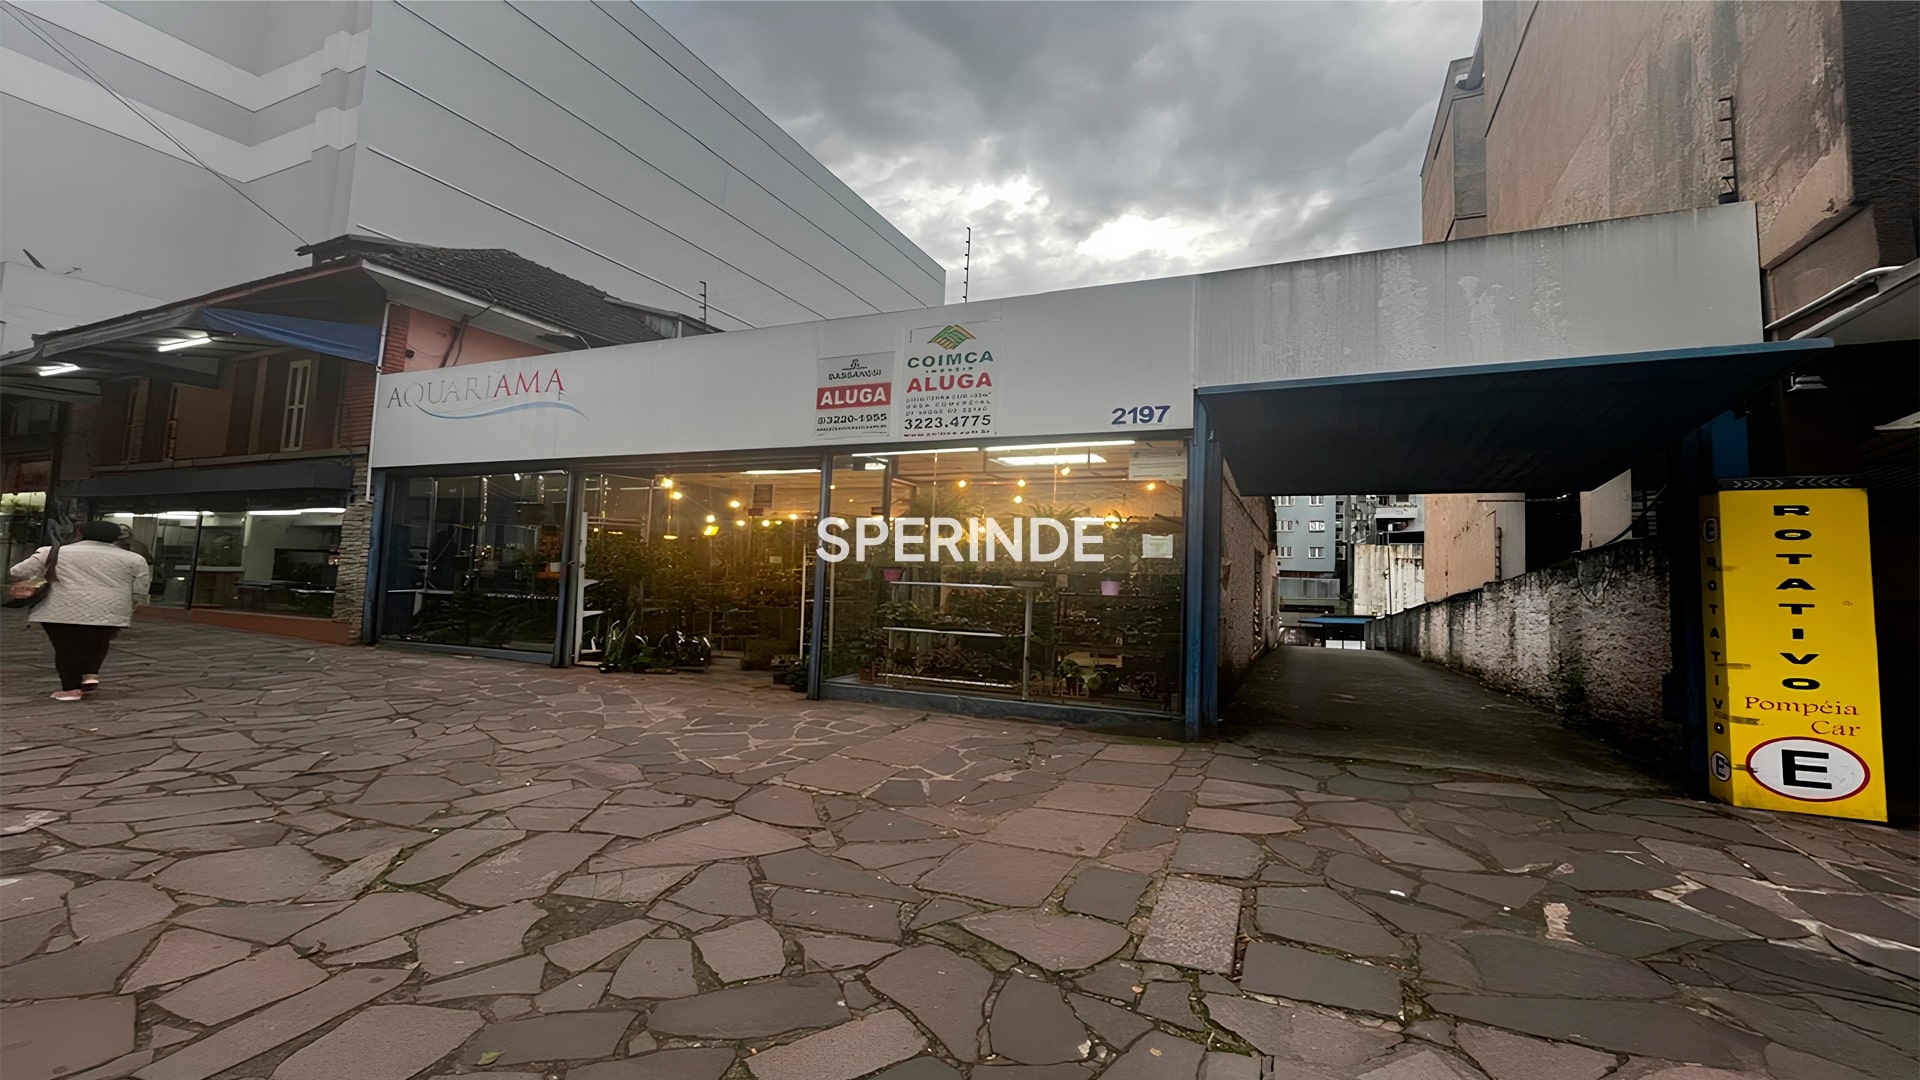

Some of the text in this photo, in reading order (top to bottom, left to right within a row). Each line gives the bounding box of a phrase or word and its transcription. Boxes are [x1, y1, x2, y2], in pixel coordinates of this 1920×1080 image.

[907, 350, 994, 368] COIMCA
[387, 368, 565, 409] AQUARIAMA
[906, 371, 992, 393] ALUGA
[820, 386, 887, 406] ALUGA
[904, 414, 991, 430] 3223.4775
[1111, 405, 1171, 425] 2197
[1773, 505, 1820, 690] ROTATIVO
[1706, 556, 1725, 735] ROTATIVO
[1745, 696, 1860, 717] Pompéia
[1811, 720, 1861, 737] Car
[1715, 754, 1727, 779] E
[1781, 749, 1832, 790] E
